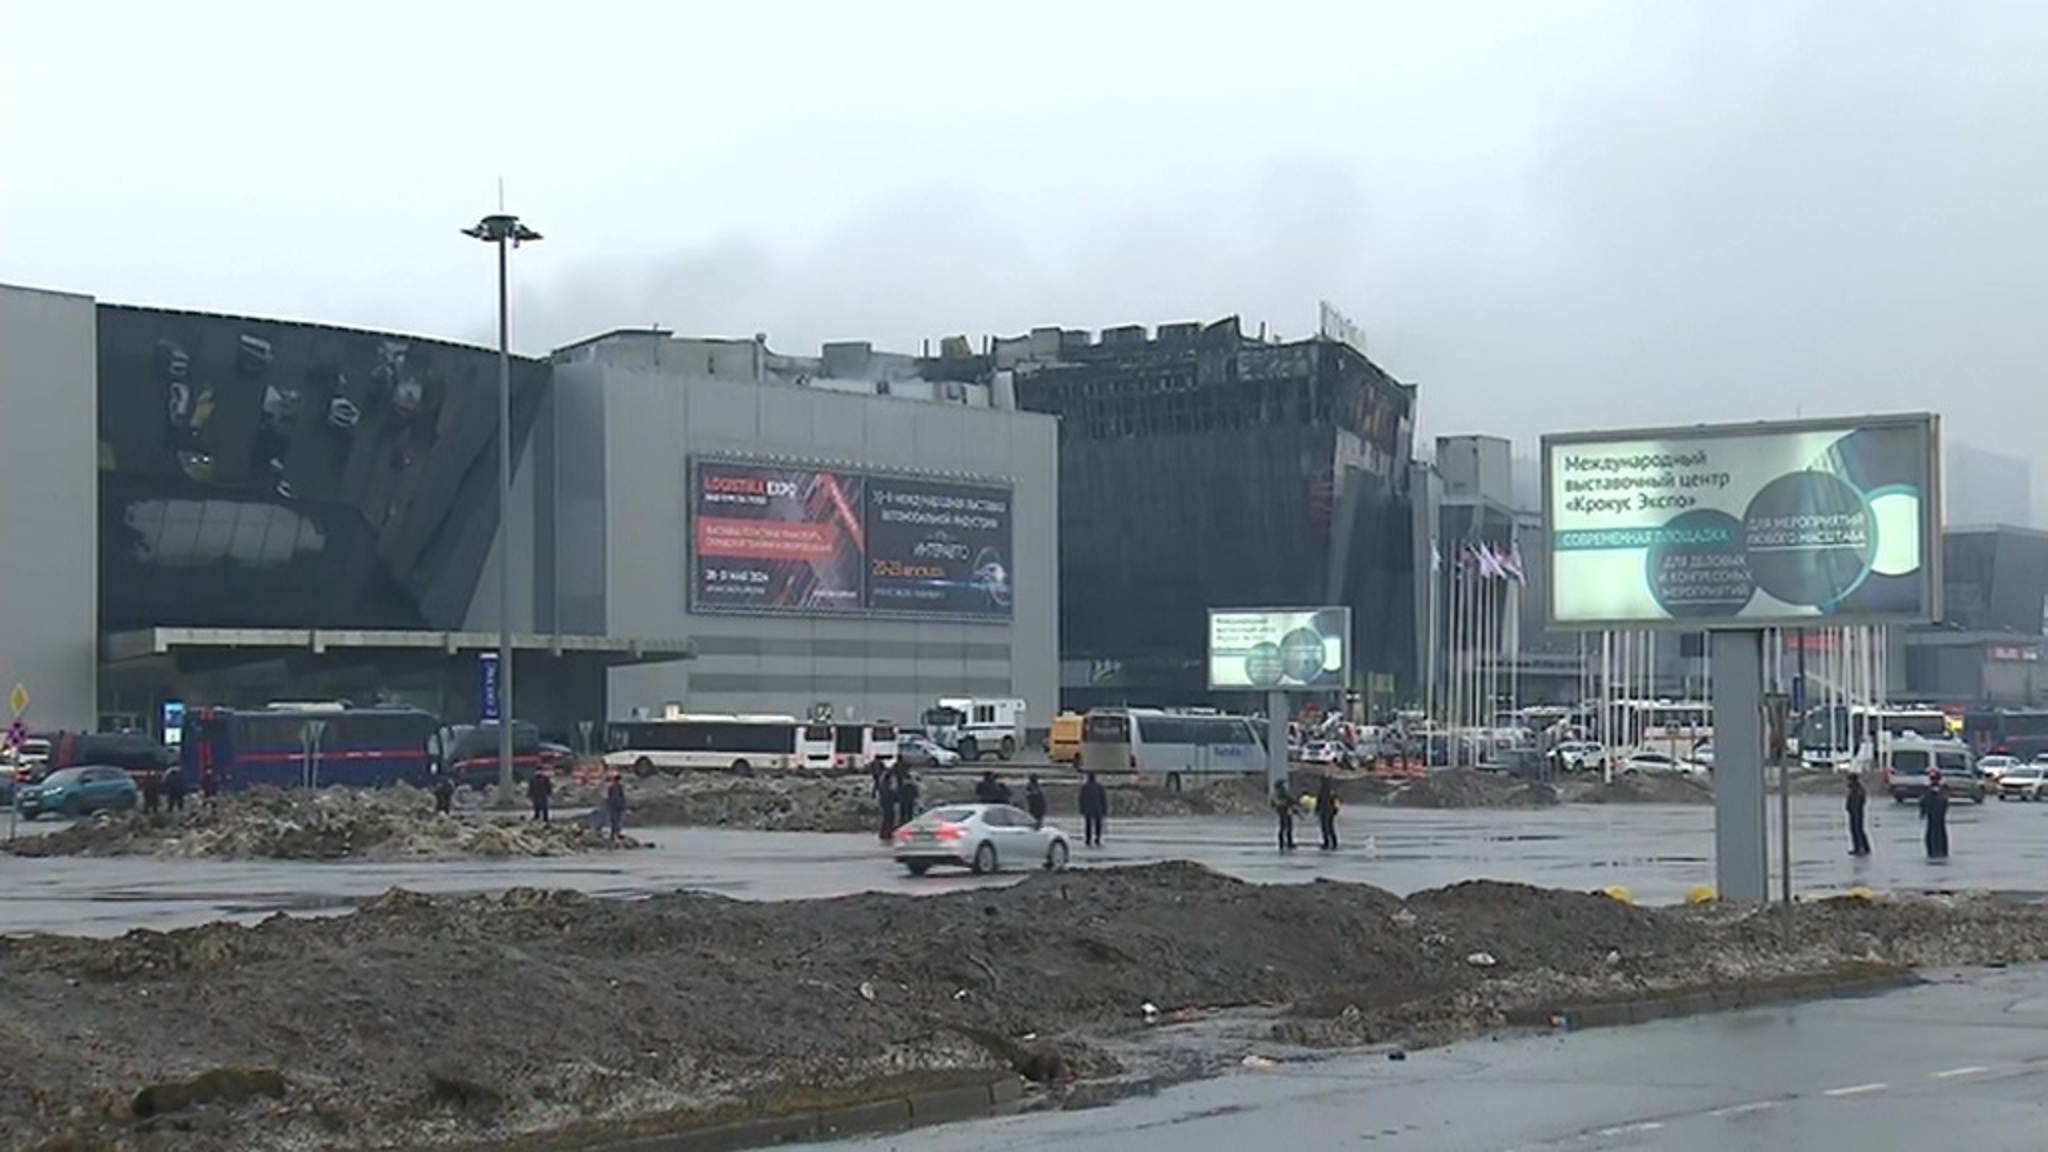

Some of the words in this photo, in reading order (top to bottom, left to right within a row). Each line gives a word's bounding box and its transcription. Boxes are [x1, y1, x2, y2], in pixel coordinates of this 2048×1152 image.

[1564, 451, 1708, 473] Международный
[1565, 472, 1676, 492] выставочный
[1679, 472, 1731, 489] центр
[1566, 495, 1632, 514] «Крокус
[1638, 493, 1696, 510] Экспо»
[1562, 530, 1650, 546] СОВРЕМЕННАЯ
